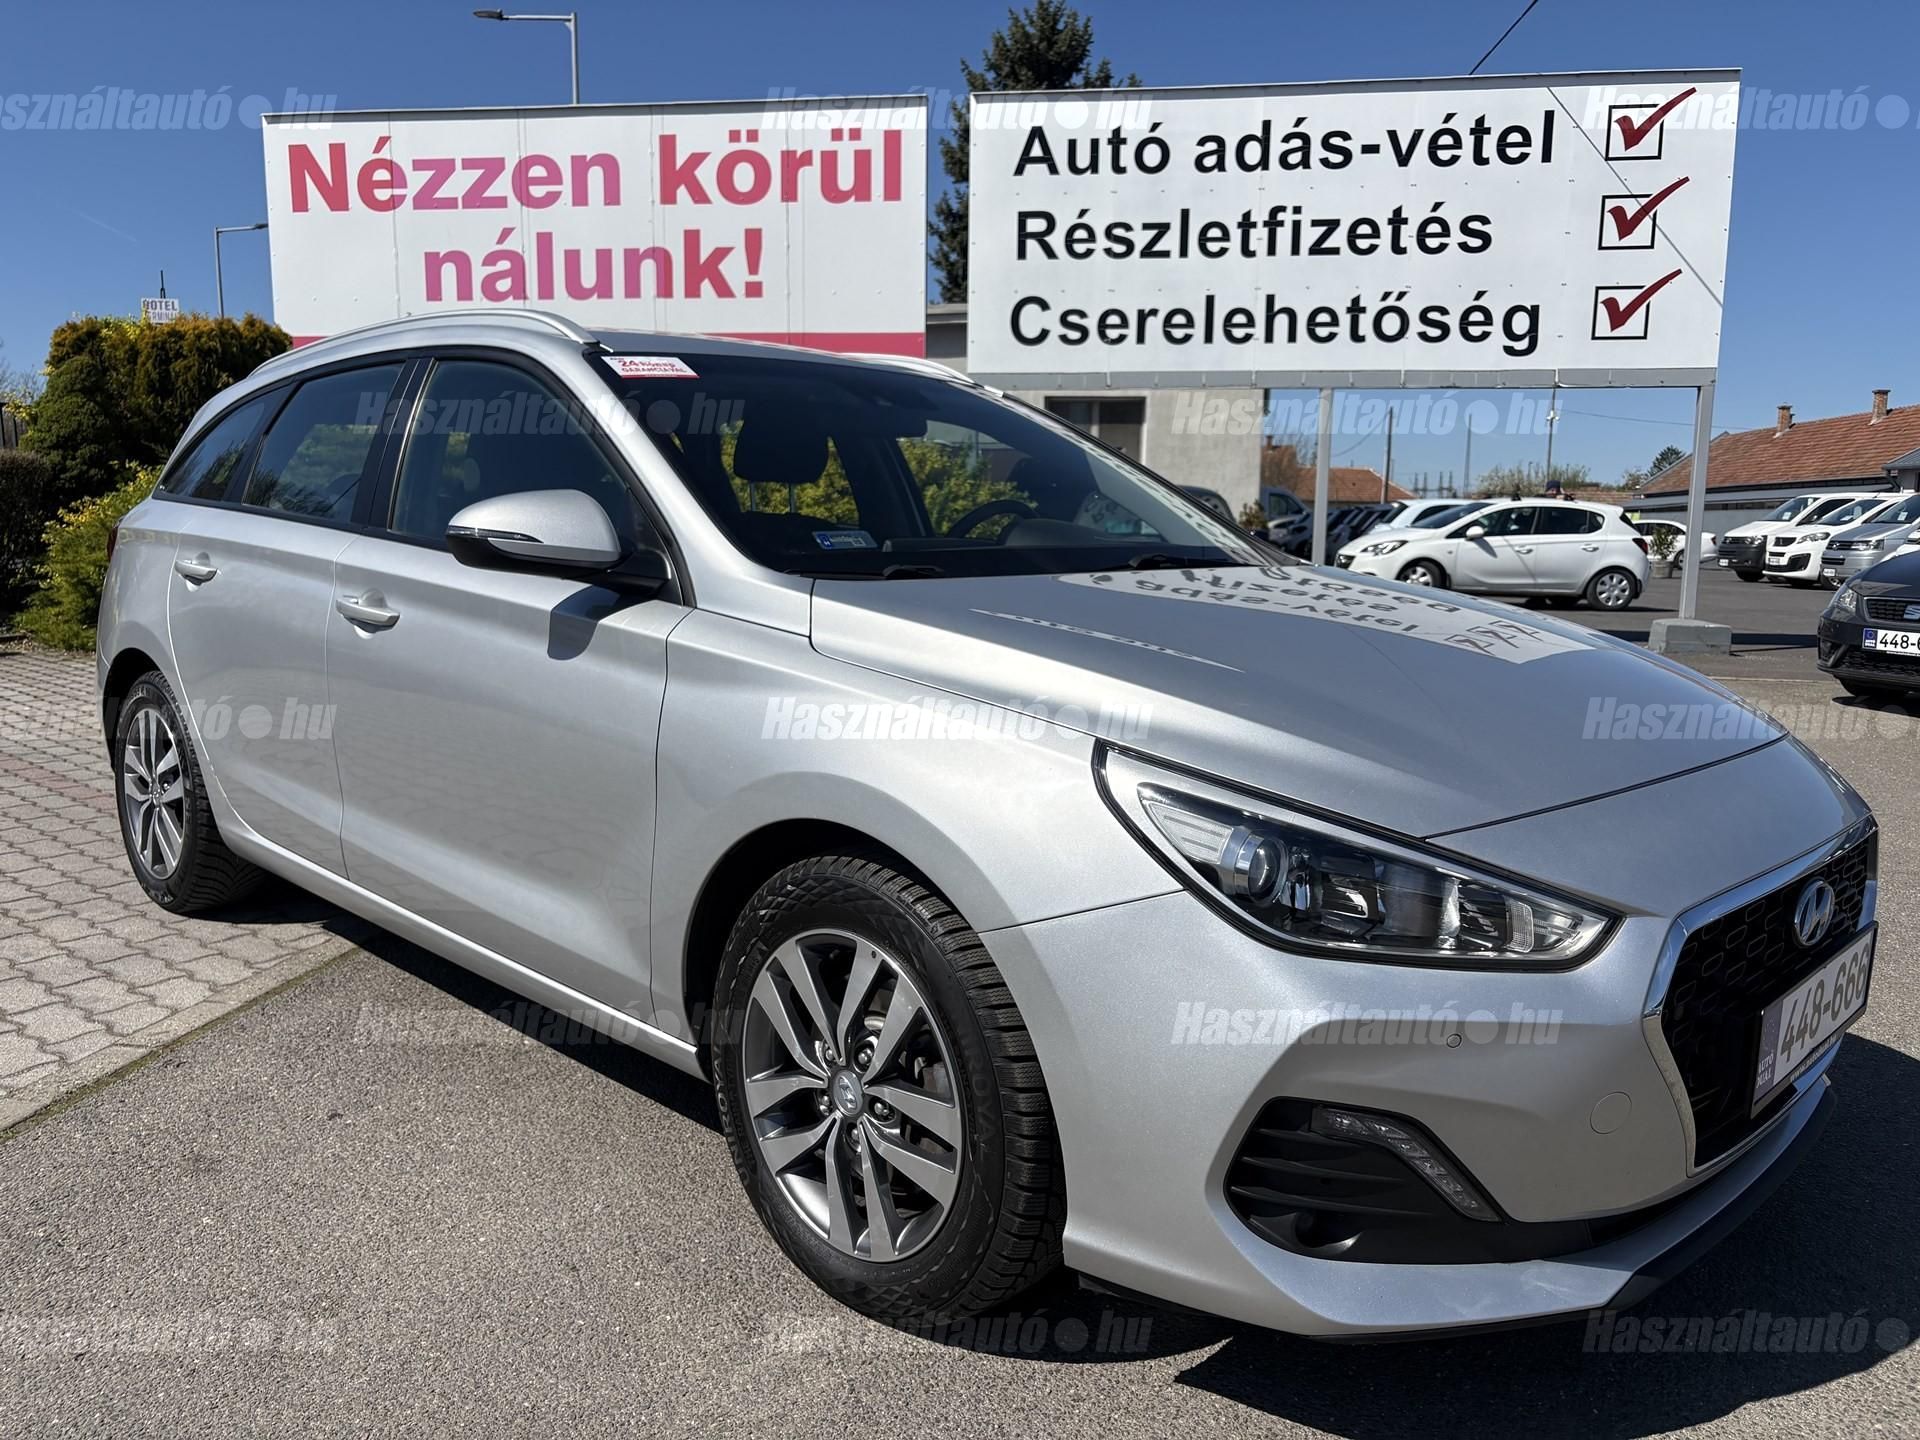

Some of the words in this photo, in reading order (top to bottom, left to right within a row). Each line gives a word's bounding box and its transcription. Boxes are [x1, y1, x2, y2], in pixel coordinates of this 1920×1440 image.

[289, 136, 620, 212] Nézzen
[660, 128, 902, 205] körül
[1015, 123, 1169, 176] Autó
[1195, 110, 1554, 173] adás-vétel
[1017, 202, 1492, 260] Részletfizetés
[425, 228, 763, 302] nálunk!
[1010, 291, 1540, 357] Cserelehetőség
[1879, 633, 1920, 652] 448-
[1780, 943, 1870, 1063] 448-666
